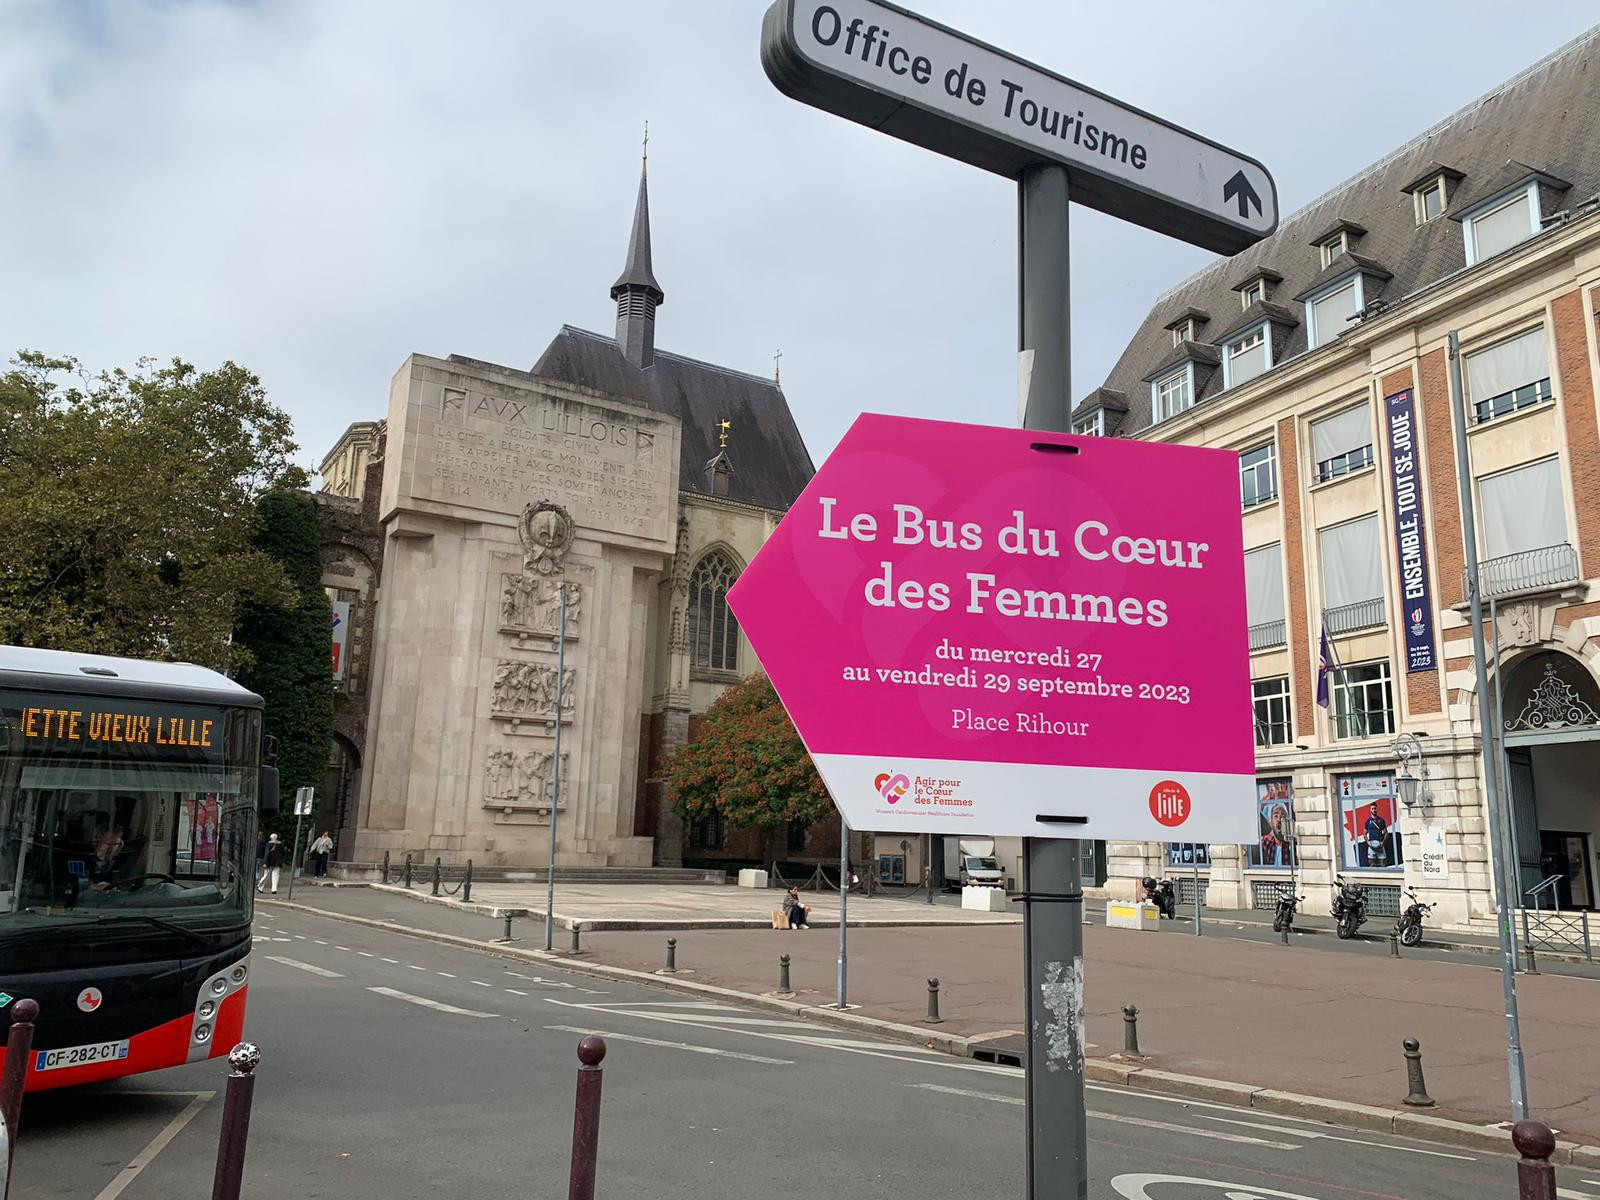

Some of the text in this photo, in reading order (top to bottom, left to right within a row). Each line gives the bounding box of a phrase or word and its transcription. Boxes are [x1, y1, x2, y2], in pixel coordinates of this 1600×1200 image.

[811, 5, 1147, 170] Office de Tourisme
[503, 425, 552, 444] SOLDATS
[563, 439, 600, 455] CIVILS
[541, 408, 629, 447] LILLOIS
[1391, 410, 1412, 451] JOUE
[438, 428, 452, 437] LA
[541, 449, 554, 460] CE
[437, 441, 452, 452] DE
[459, 445, 519, 465] RAPPELER
[586, 471, 605, 482] DES
[512, 469, 527, 479] ET
[532, 472, 551, 485] LES
[1394, 451, 1413, 472] SE
[434, 467, 455, 479] SES
[462, 472, 514, 491] ENFANTS
[520, 483, 559, 498] MORTS
[443, 482, 470, 496] 1914
[1397, 472, 1416, 516] TOUT
[818, 496, 1210, 569] Le Bus du Cœur
[1400, 513, 1425, 600] ENSEMBLE,
[864, 561, 1168, 628] des Femmes
[935, 638, 1103, 672] du mercredi 27
[1411, 656, 1431, 668] 2023
[842, 666, 1191, 705] au vendredi 29 septembre 2023
[22, 708, 213, 747] ETTE VIEUX LILLE
[951, 707, 1089, 736] Place Rihour
[914, 776, 961, 788] Agir pour
[914, 784, 953, 796] le Cœur
[914, 794, 973, 807] des Femmes
[46, 1043, 119, 1067] CF-282-CT
